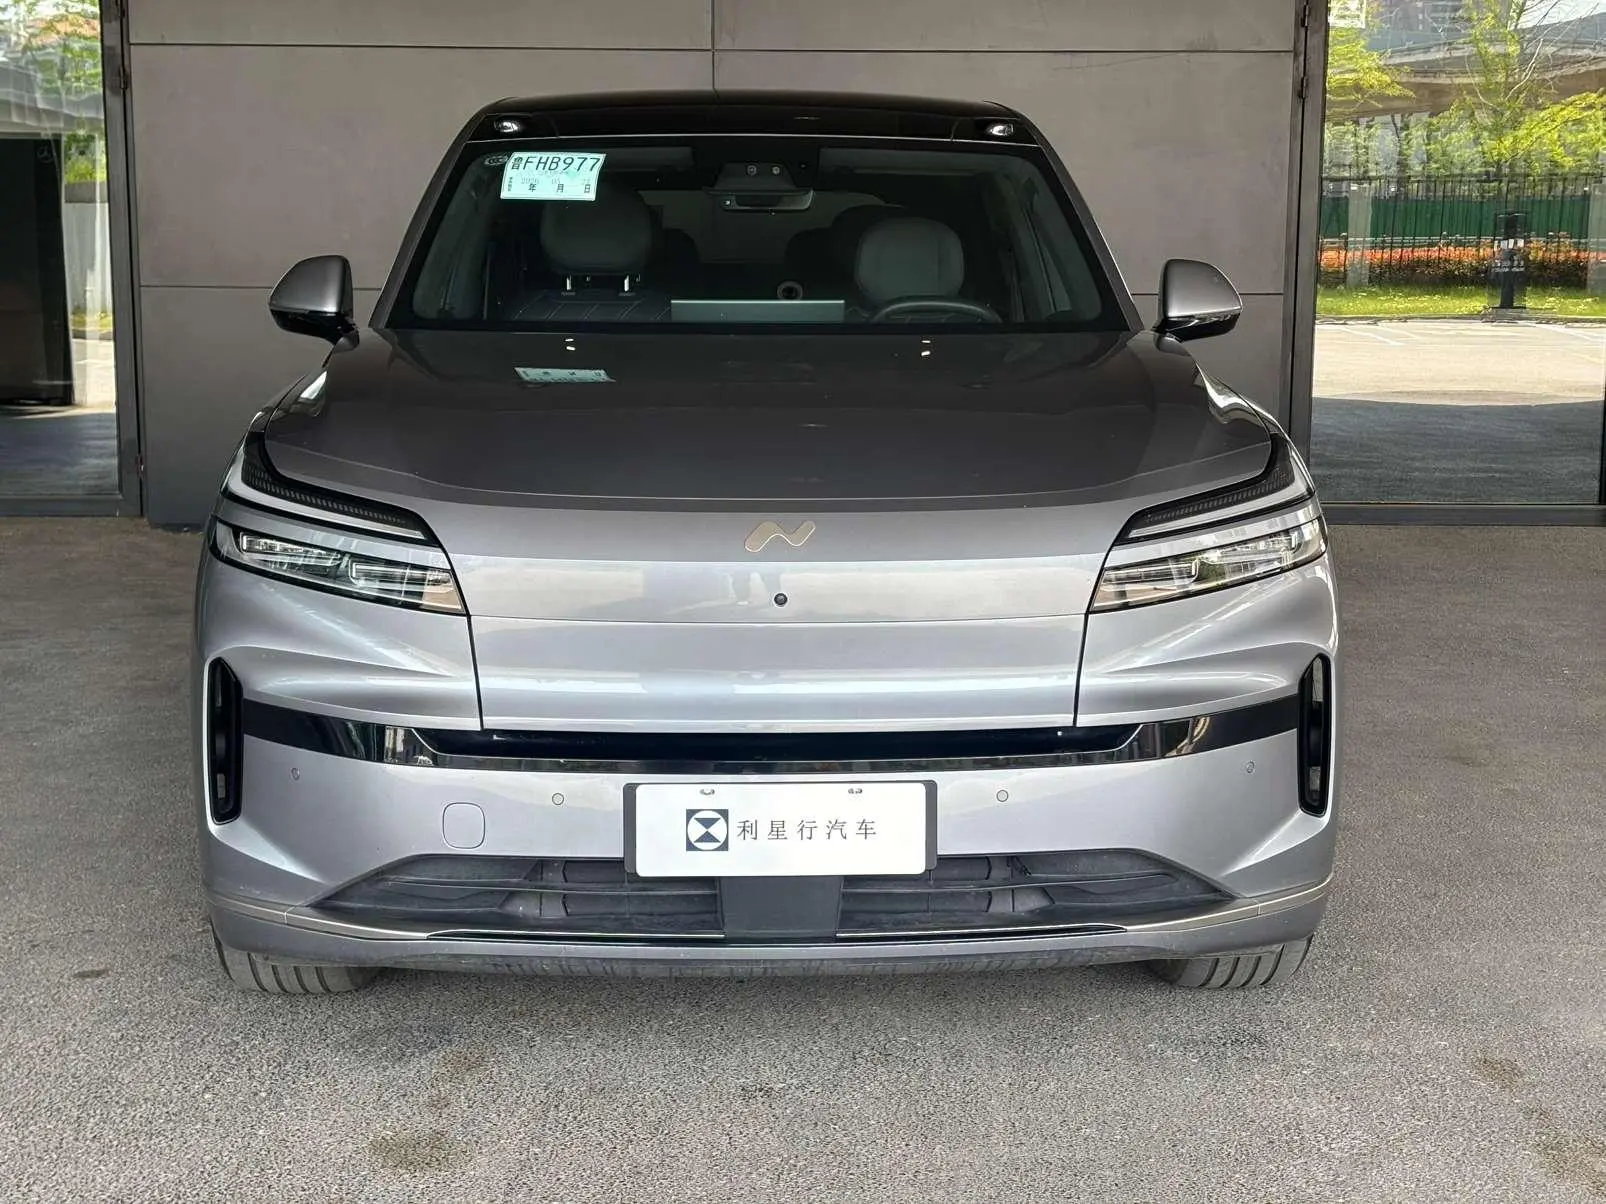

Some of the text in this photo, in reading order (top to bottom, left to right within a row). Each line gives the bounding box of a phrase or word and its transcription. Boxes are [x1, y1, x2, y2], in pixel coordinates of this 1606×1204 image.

[511, 156, 601, 172] 鲁FHB977
[528, 184, 591, 193] 年 月 日
[737, 819, 877, 841] 利星行汽车
